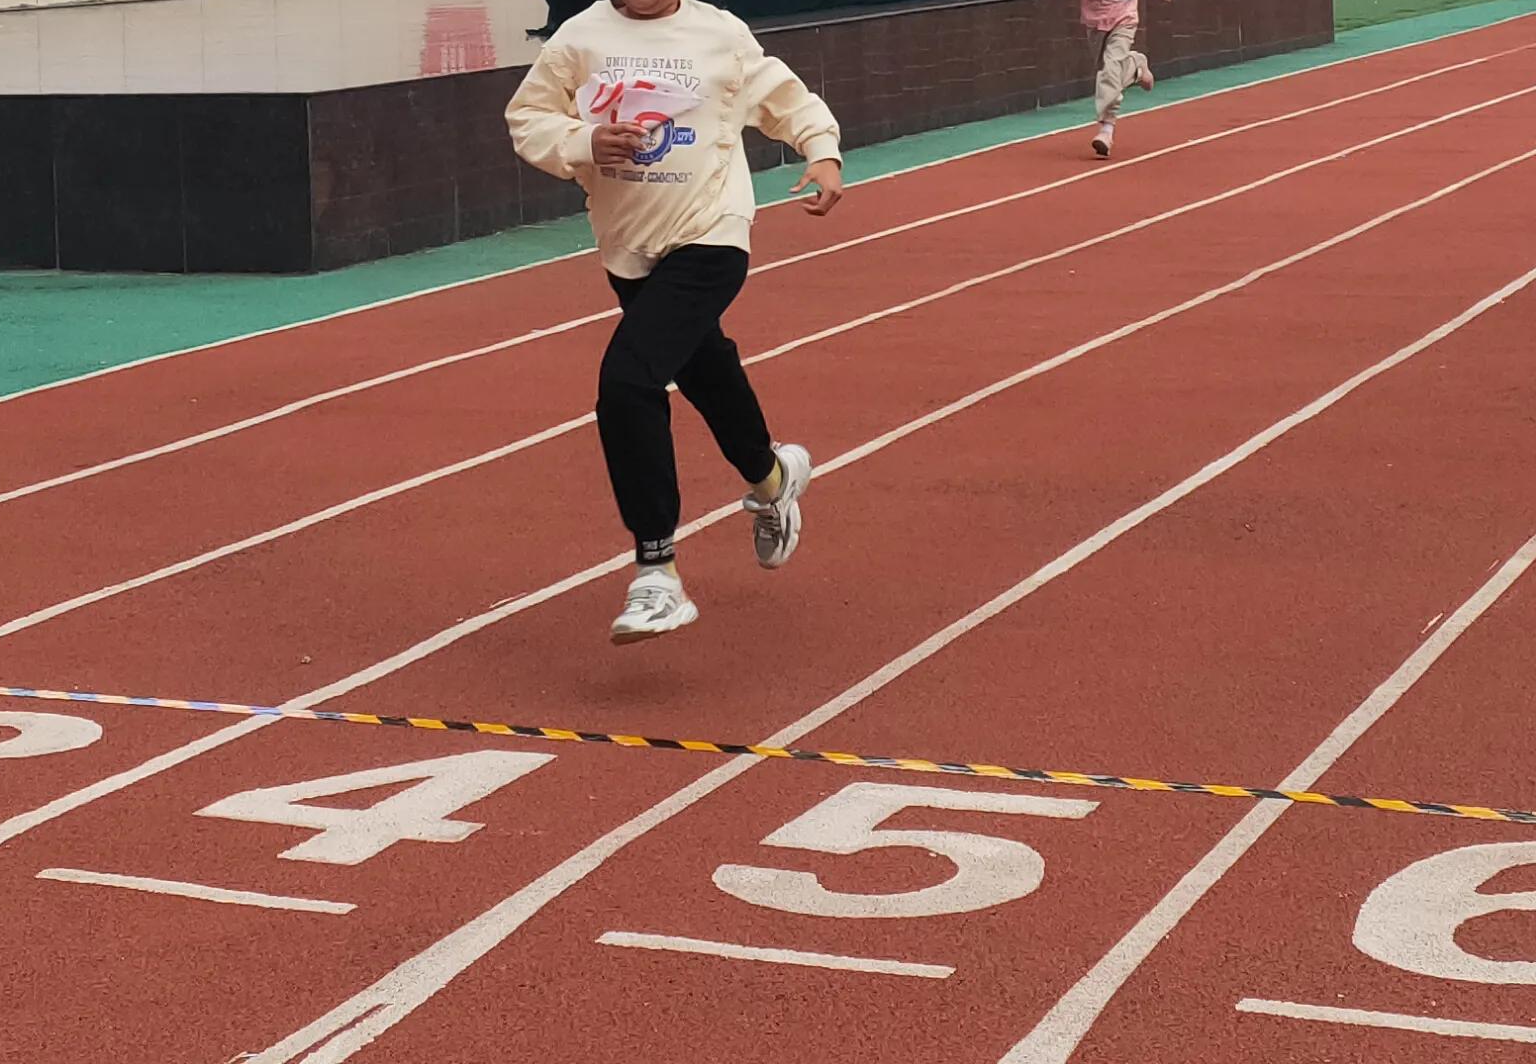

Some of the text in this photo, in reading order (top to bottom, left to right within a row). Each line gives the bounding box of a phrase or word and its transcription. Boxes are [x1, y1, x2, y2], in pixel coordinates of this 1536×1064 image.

[652, 58, 694, 70] STATES
[194, 749, 557, 865] 4
[711, 781, 1100, 918] 5
